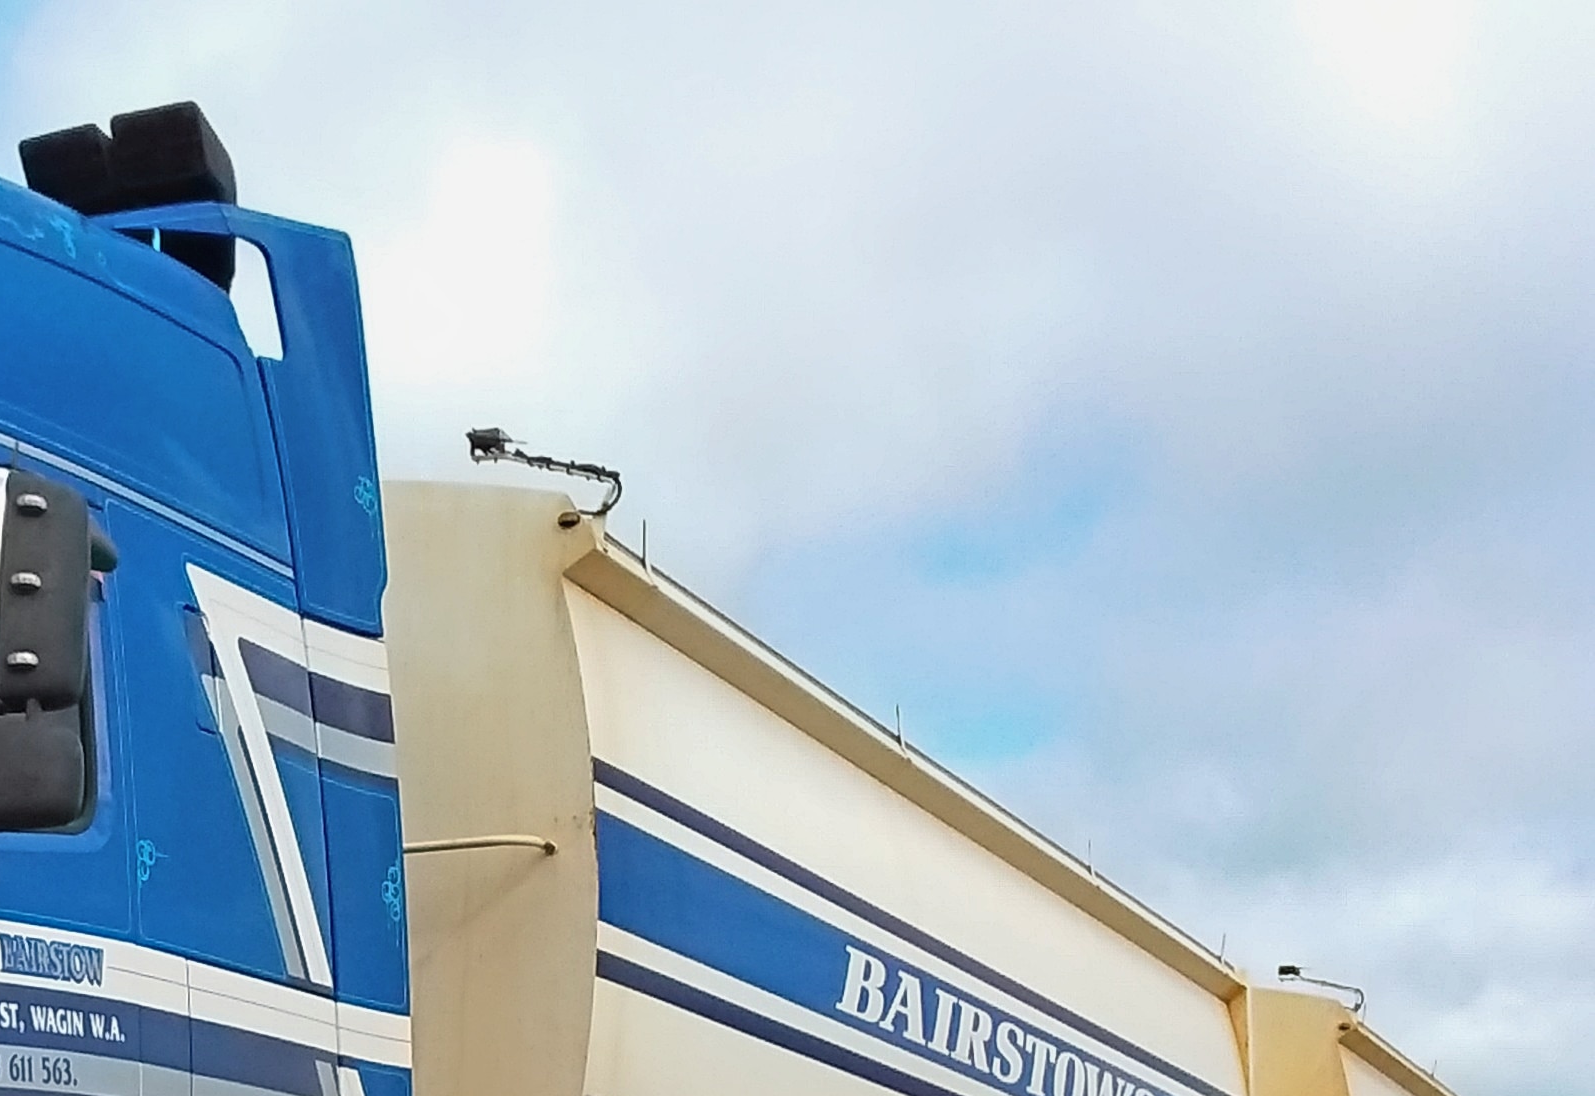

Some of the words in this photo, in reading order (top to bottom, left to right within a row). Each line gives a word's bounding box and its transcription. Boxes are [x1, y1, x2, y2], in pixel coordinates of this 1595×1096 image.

[0, 932, 104, 987] BAIRSTOW
[0, 1001, 25, 1032] ST,
[31, 1009, 85, 1037] WAGIN
[90, 1013, 125, 1042] W.A.
[9, 1056, 34, 1084] 611
[41, 1059, 78, 1087] 563.
